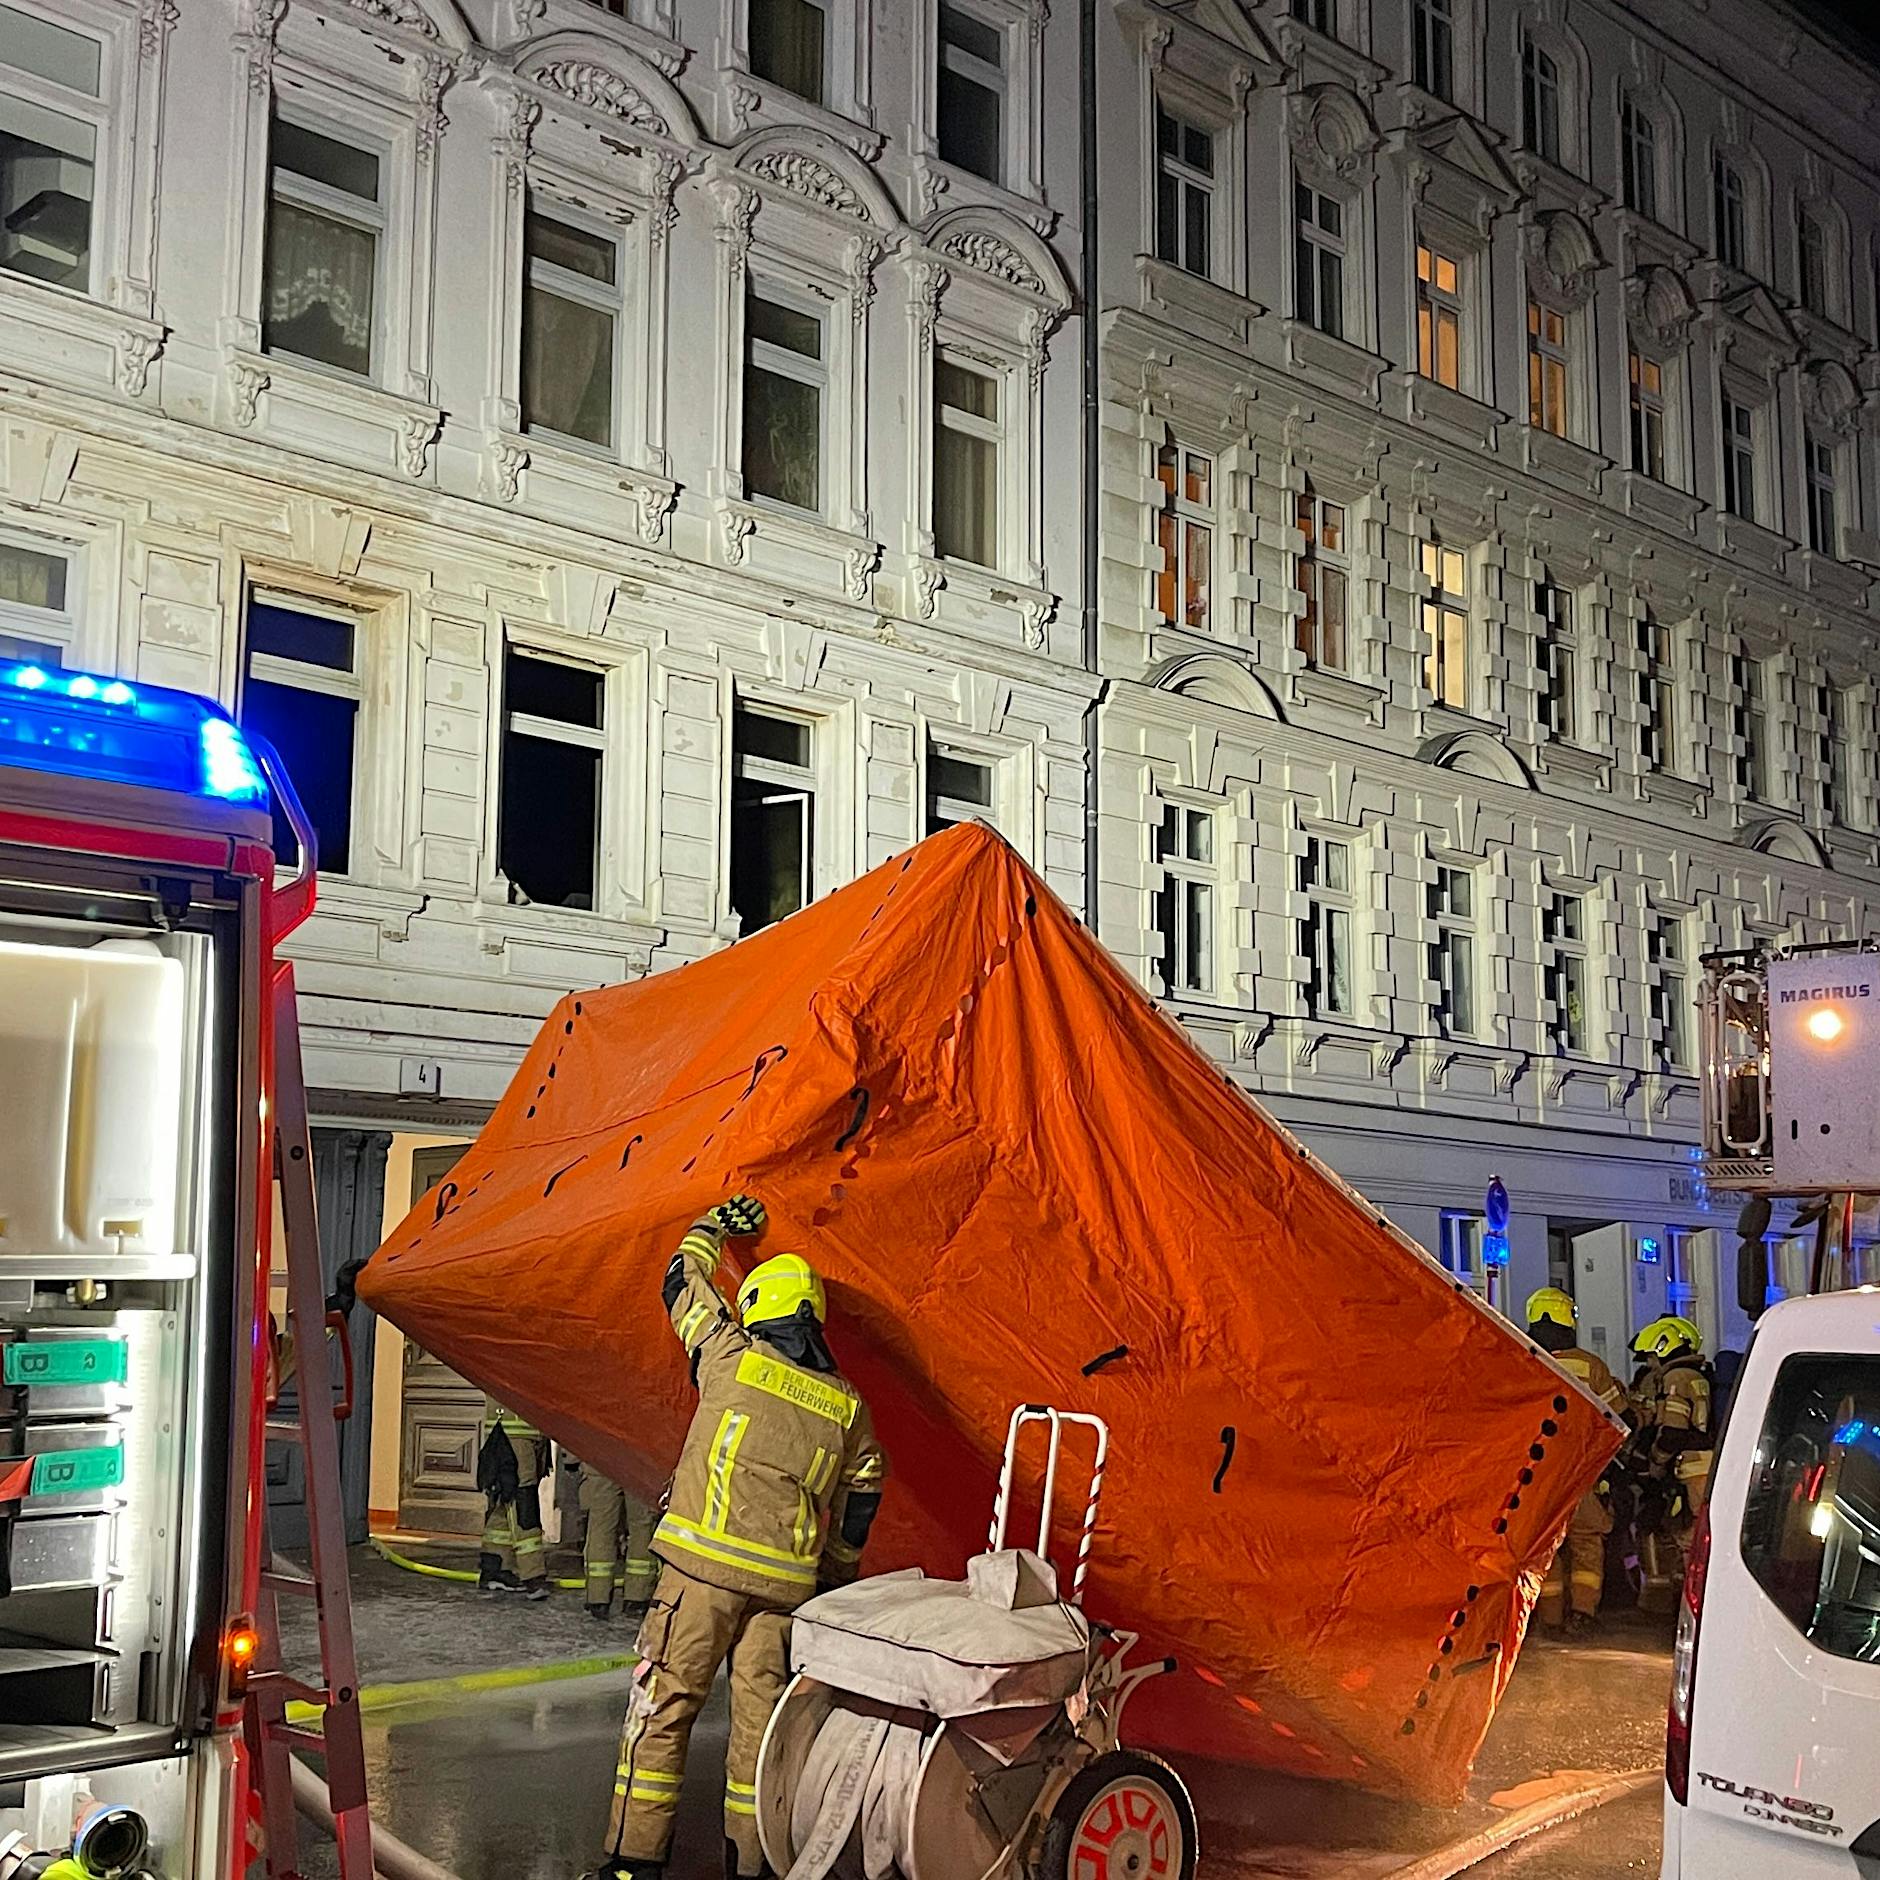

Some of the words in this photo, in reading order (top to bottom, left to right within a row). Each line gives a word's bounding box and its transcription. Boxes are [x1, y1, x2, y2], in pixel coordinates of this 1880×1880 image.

[1780, 984, 1870, 1003] MAGIRUS
[418, 1064, 426, 1083] 4
[783, 1370, 827, 1395] BERLINER
[779, 1381, 844, 1418] FEUERWEHR
